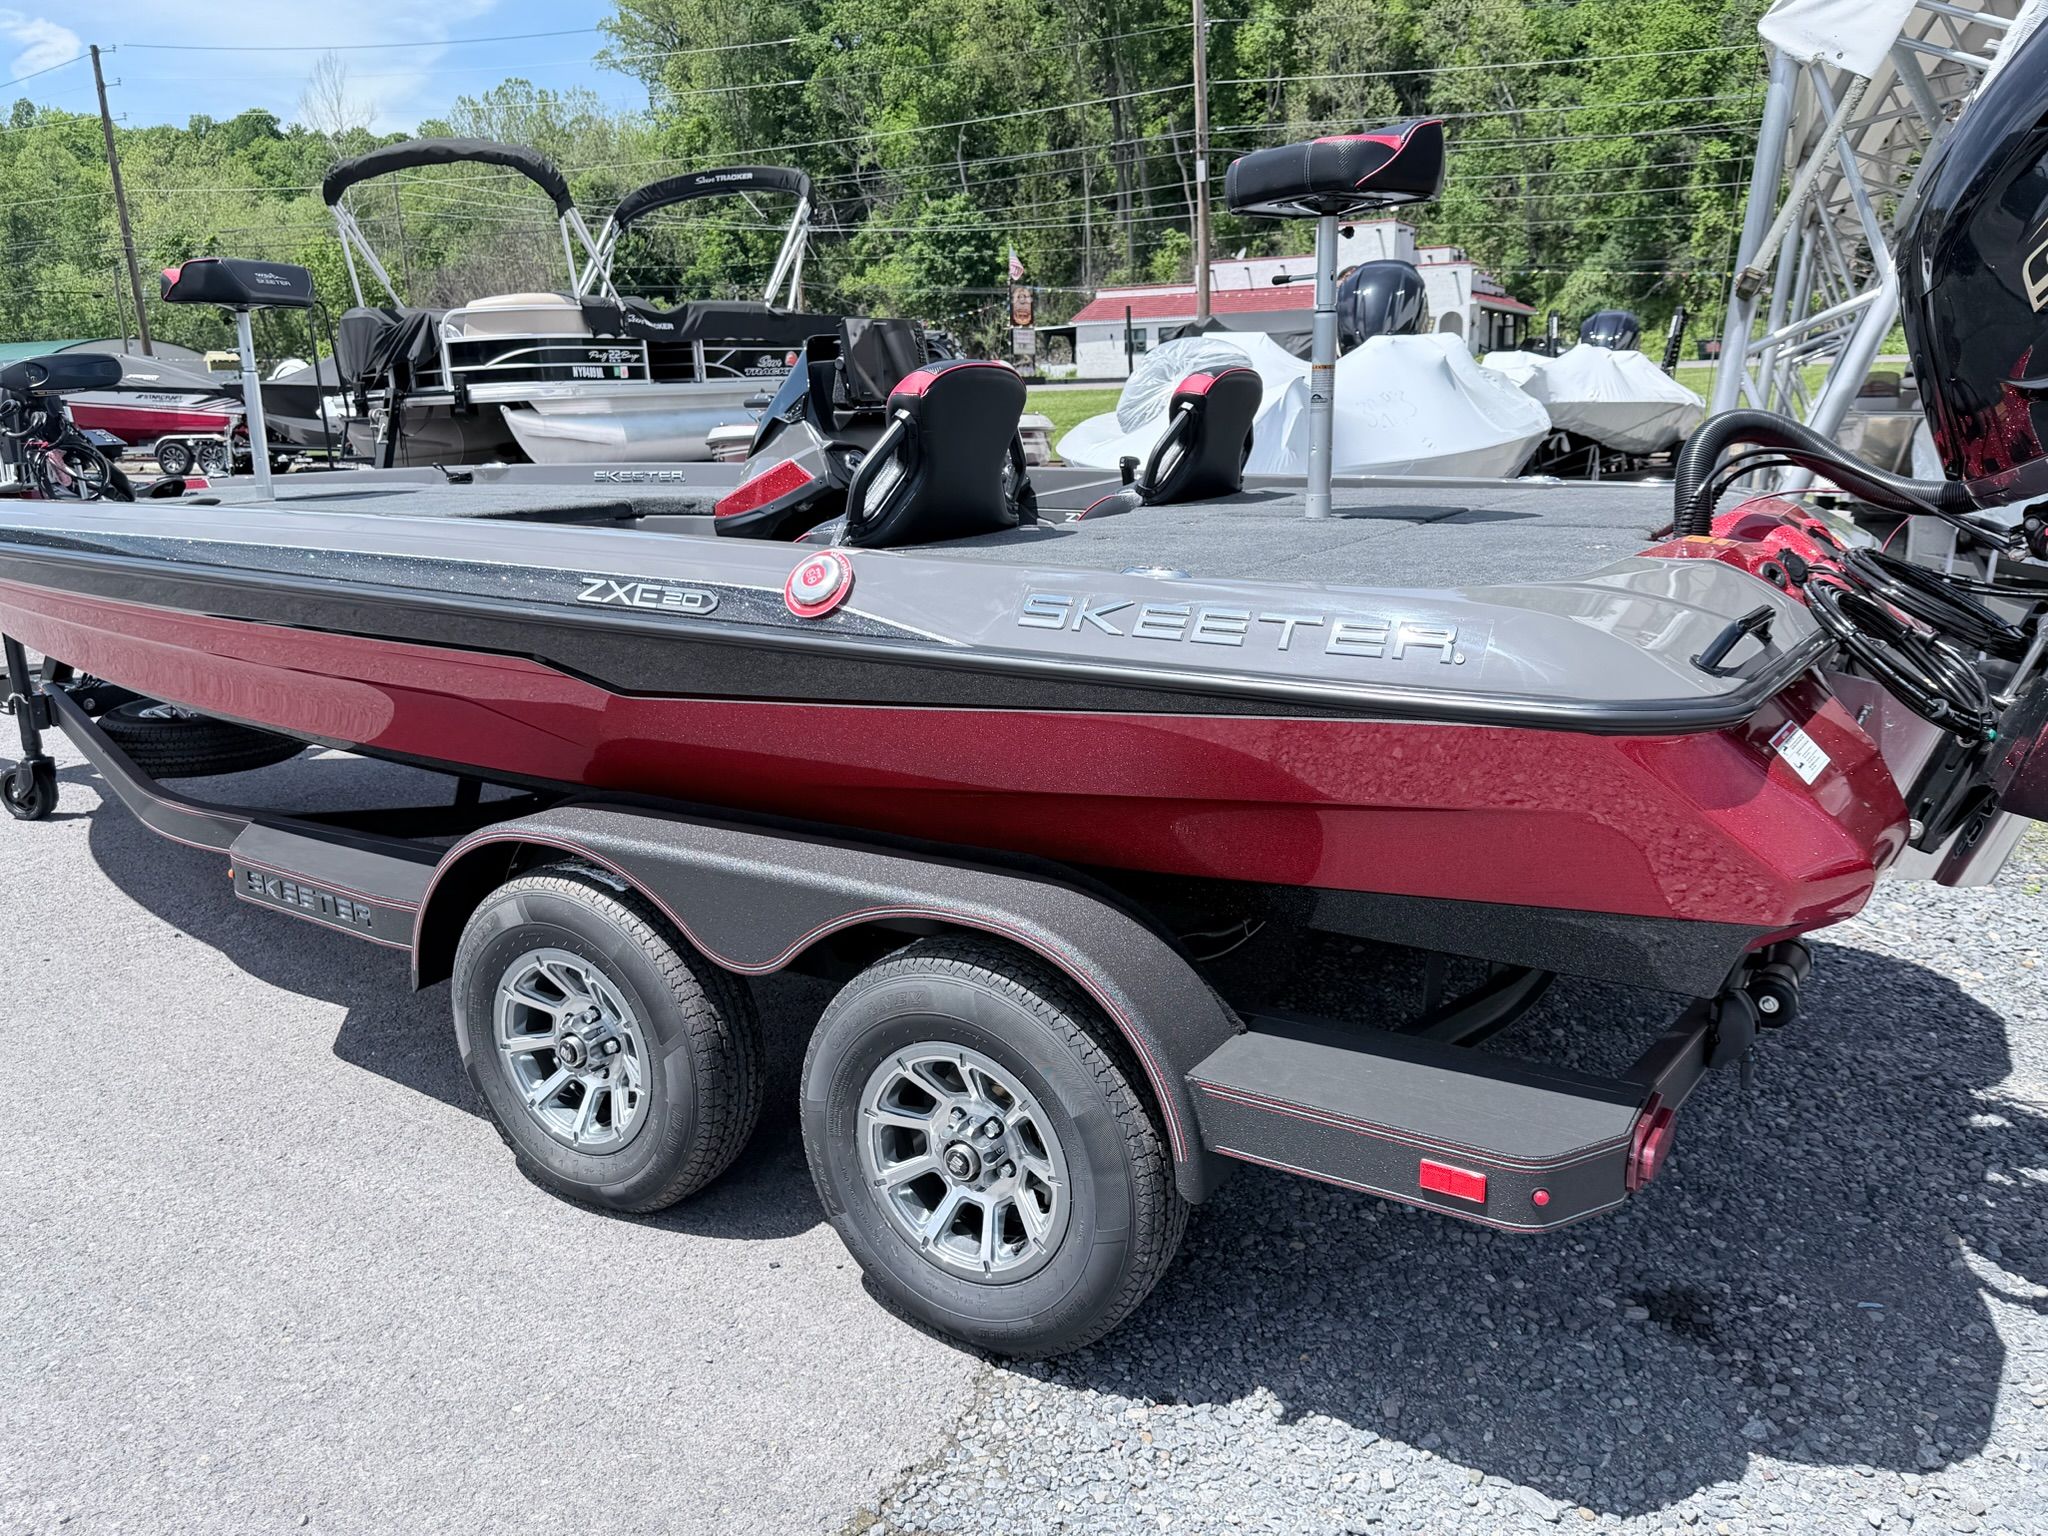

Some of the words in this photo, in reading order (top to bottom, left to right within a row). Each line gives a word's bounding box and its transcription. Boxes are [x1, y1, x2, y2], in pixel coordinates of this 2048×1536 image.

[715, 172, 753, 183] TRACKER
[608, 349, 621, 359] 22
[593, 470, 684, 483] SKEETER
[1017, 593, 1460, 665] SKEETER
[247, 870, 373, 928] SKEETER
